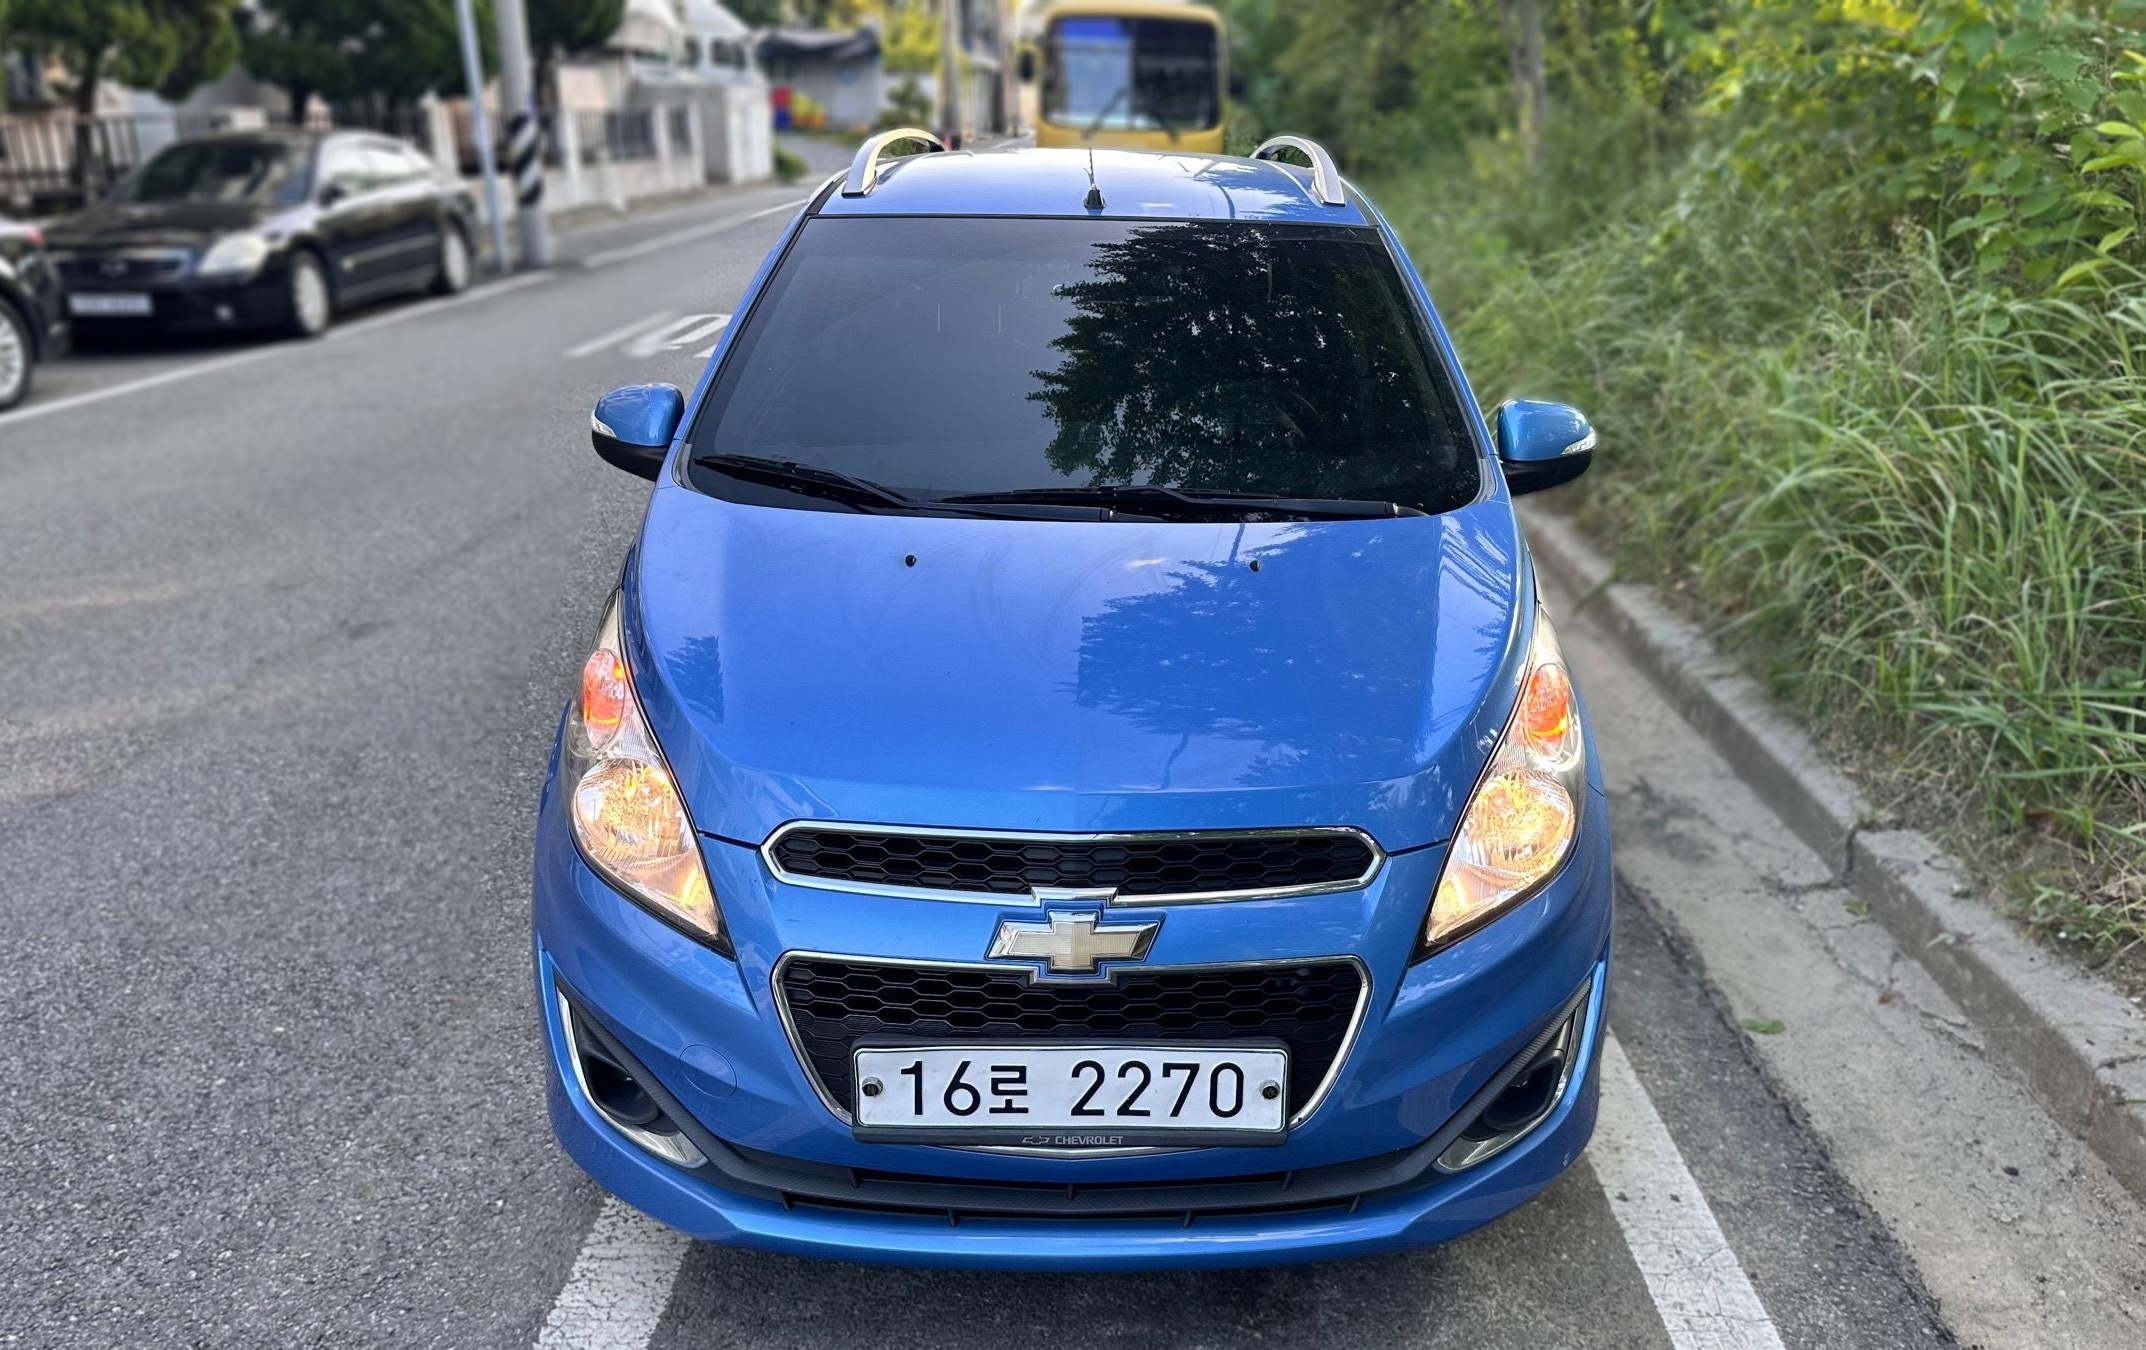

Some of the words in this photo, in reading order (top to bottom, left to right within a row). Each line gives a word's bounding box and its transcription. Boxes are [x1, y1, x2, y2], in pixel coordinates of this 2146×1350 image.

[900, 1060, 1029, 1117] 16로
[1070, 1060, 1244, 1118] 2270
[1055, 1135, 1124, 1146] CHEVROLET
